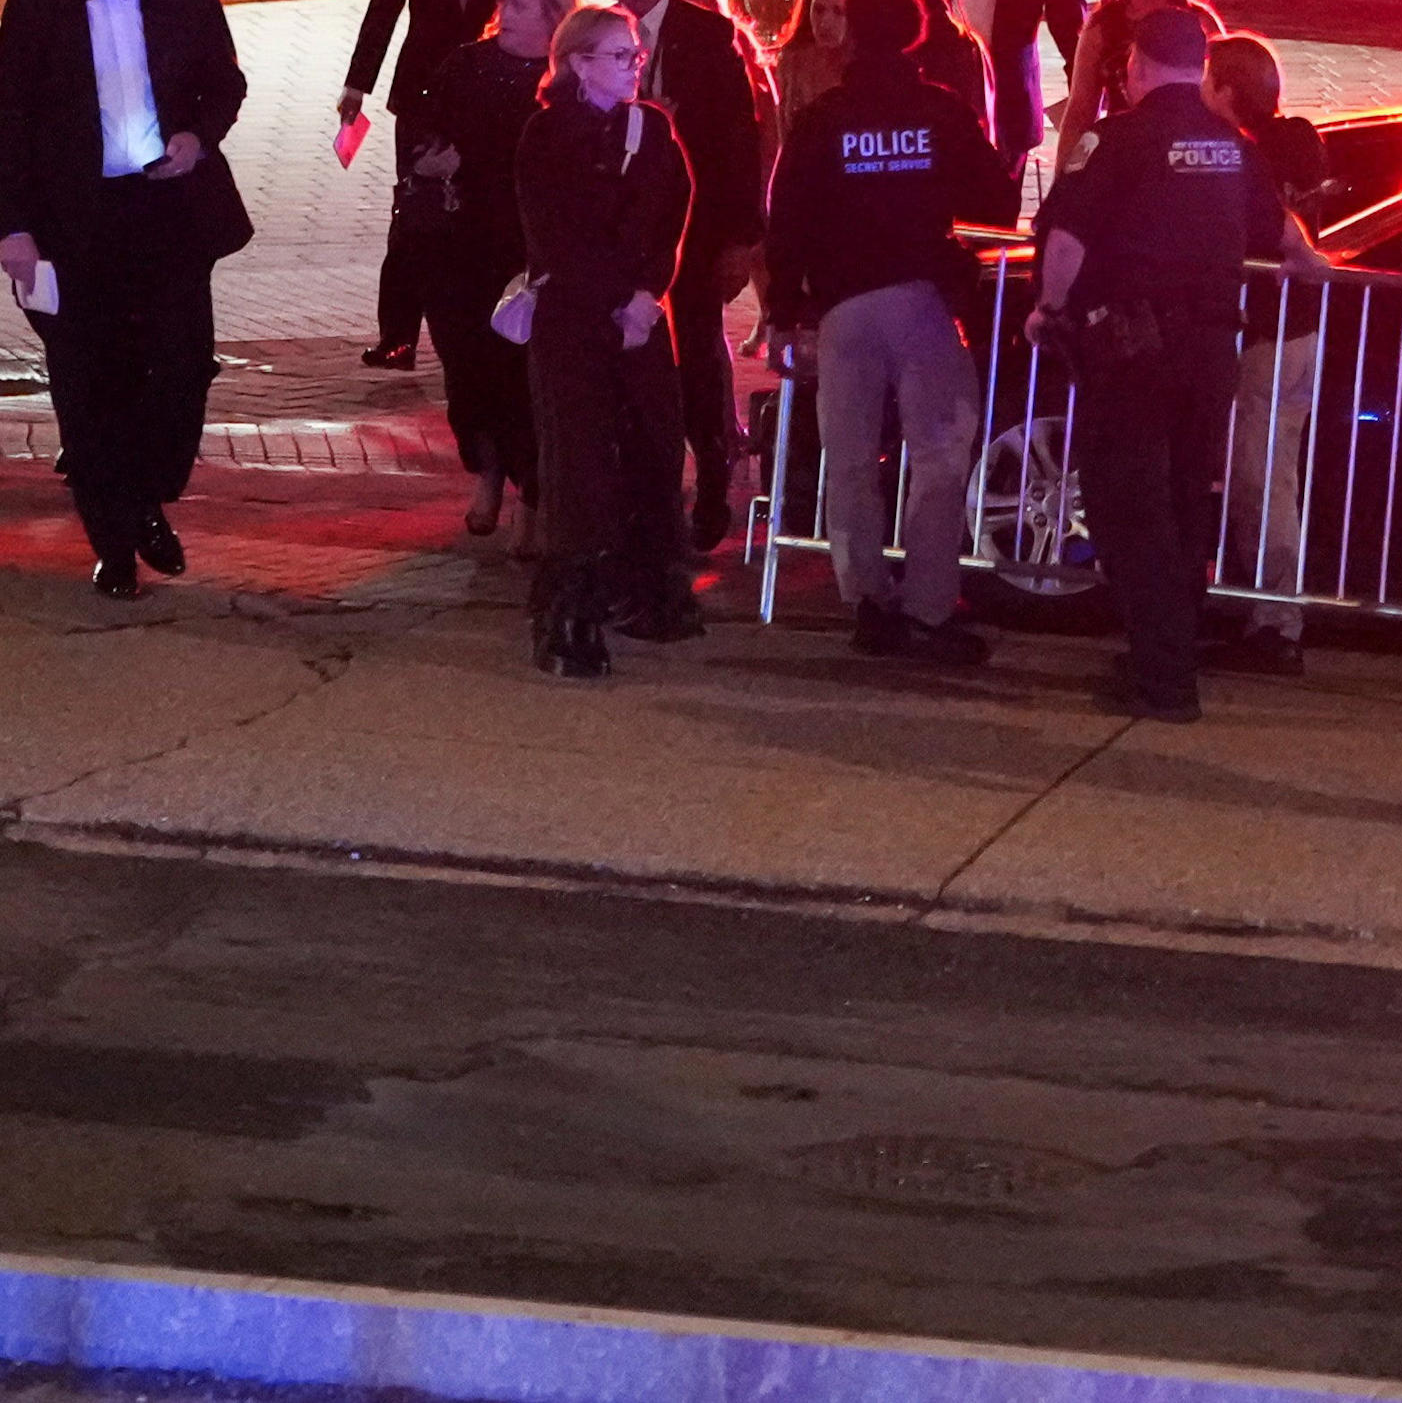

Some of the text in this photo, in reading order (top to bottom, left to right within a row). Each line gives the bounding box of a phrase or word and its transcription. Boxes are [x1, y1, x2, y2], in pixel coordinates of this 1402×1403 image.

[842, 128, 932, 158] POLICE
[844, 158, 932, 174] SECRET SERVICE
[1168, 149, 1242, 166] POLICE
